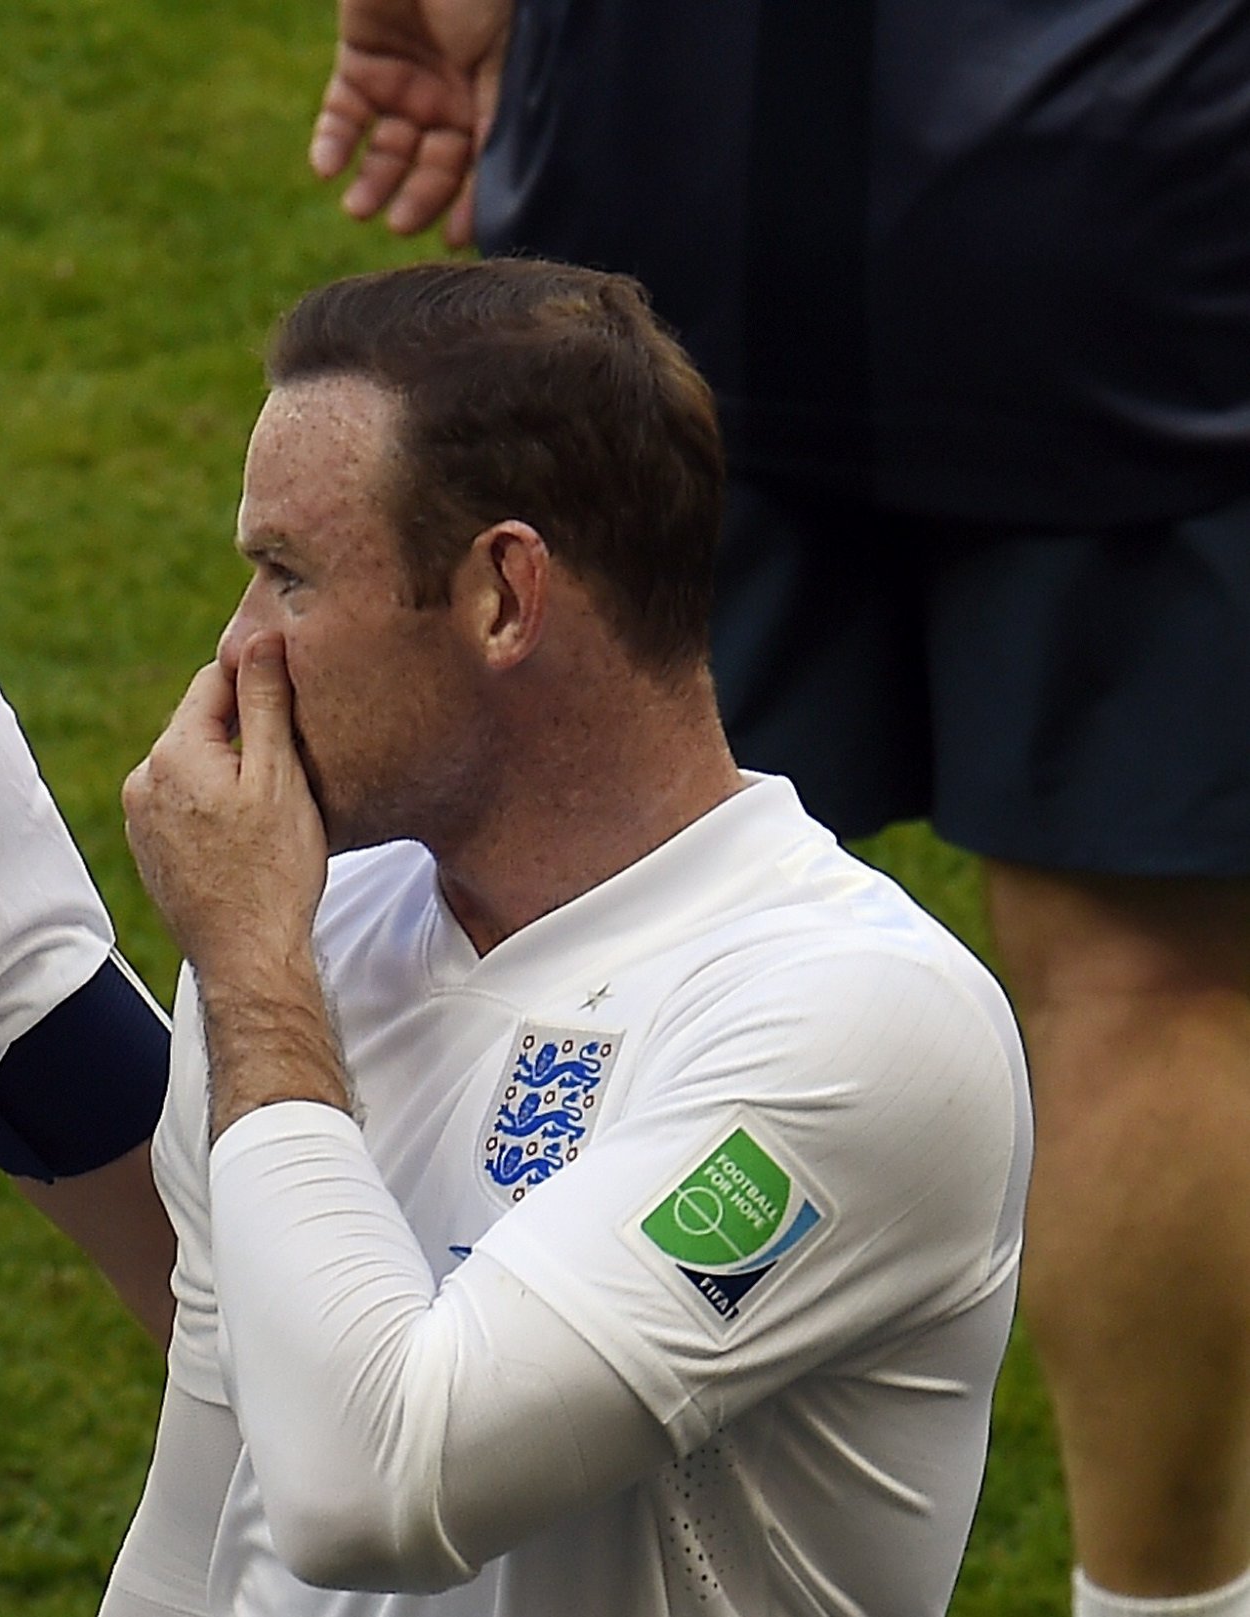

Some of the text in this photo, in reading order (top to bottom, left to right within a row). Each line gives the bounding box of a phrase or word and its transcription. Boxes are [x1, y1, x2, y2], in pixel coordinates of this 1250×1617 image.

[704, 1165, 766, 1230] FOR HOPE
[715, 1153, 778, 1222] FOOTBALL
[700, 1277, 729, 1312] FIFA
